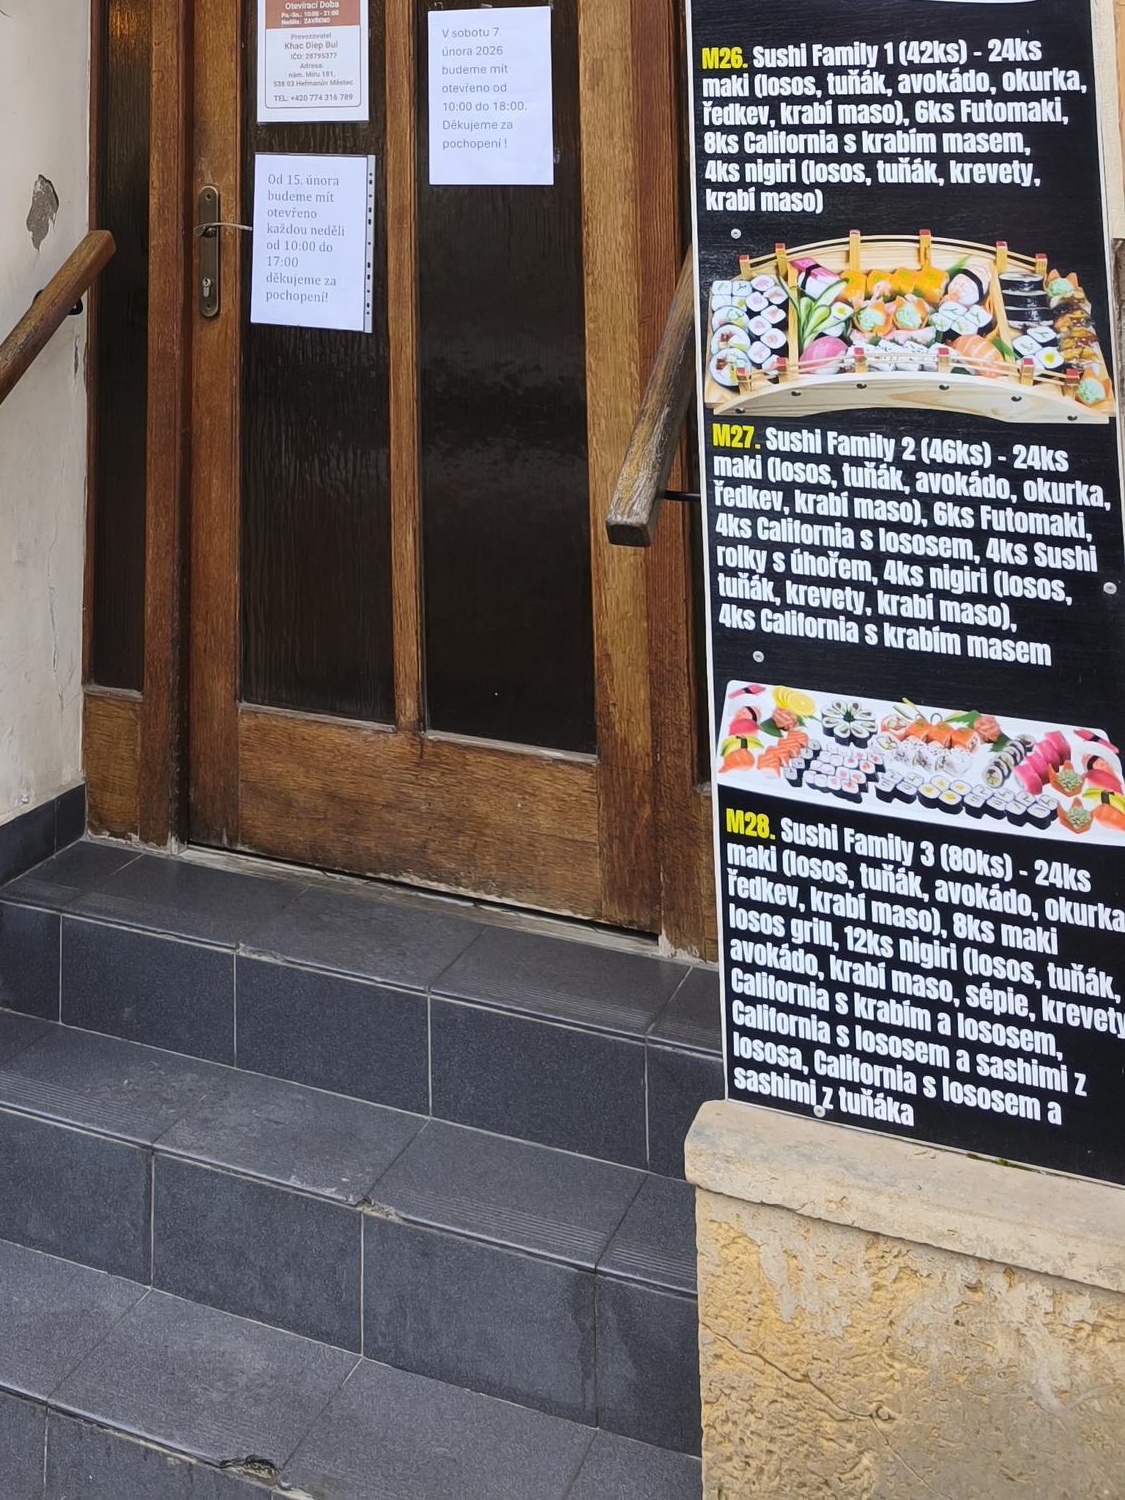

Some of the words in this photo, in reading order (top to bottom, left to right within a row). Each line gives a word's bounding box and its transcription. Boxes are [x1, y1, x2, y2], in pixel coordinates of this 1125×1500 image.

[442, 29, 449, 38] V
[452, 28, 489, 37] sobotu
[492, 28, 503, 36] 7.
[306, 42, 323, 50] Diep
[442, 47, 472, 56] února
[476, 46, 503, 55] 2026
[702, 47, 748, 69] M26.
[753, 43, 807, 68] Sushi
[812, 41, 879, 69] Family
[884, 43, 893, 65] 1
[899, 39, 967, 66] (42ks)
[988, 38, 1042, 62] 24ks
[442, 65, 487, 74] budeme
[490, 64, 507, 74] mít
[442, 82, 490, 92] otevřeno
[493, 83, 507, 92] od
[703, 73, 749, 97] maki
[755, 72, 822, 98] (losos,
[828, 70, 893, 97] tuňák,
[898, 69, 997, 96] avokádo,
[1002, 69, 1086, 94] okurka,
[443, 102, 472, 111] 10:00
[475, 102, 489, 111] do
[494, 101, 527, 110] 18:00.
[703, 101, 775, 127] ředkev,
[781, 100, 832, 124] krabí
[838, 100, 909, 127] maso),
[915, 100, 955, 123] 6ks
[961, 98, 1068, 126] Futomaki,
[443, 119, 497, 131] Děkujeme
[501, 121, 513, 129] za
[443, 138, 501, 150] pochopení
[705, 131, 738, 154] 8ks
[744, 129, 836, 154] California
[844, 132, 856, 153] s
[862, 128, 936, 153] krabím
[943, 131, 1031, 155] masem,
[705, 160, 740, 183] 4ks
[745, 159, 796, 186] nigiri
[802, 159, 871, 186] (losos,
[877, 158, 945, 186] tuňák,
[950, 160, 1041, 187] krevety,
[268, 174, 283, 185] Od
[288, 174, 303, 185] 15.
[307, 174, 339, 186] února
[268, 190, 312, 202] budeme
[315, 192, 334, 202] mít
[706, 188, 755, 212] krabí
[761, 188, 823, 214] maso)
[267, 208, 317, 218] otevřeno
[267, 223, 307, 234] každou
[311, 225, 345, 236] neděli
[267, 240, 279, 250] od
[285, 241, 315, 251] 10:00
[319, 241, 333, 252] do
[267, 256, 298, 267] 17:00
[266, 272, 321, 286] děkujeme
[324, 277, 336, 286] za
[266, 290, 328, 304] pochopení!
[712, 423, 760, 449] M27.
[766, 427, 821, 455] Sushi
[827, 430, 895, 462] Family
[902, 436, 916, 461] 2
[921, 438, 991, 468] (46ks)
[1013, 445, 1068, 472] 24ks
[726, 808, 776, 840] M28.
[780, 817, 838, 850] Sushi
[844, 827, 914, 867] Family
[920, 841, 934, 866] 3
[940, 843, 1013, 880] (80ks)
[1034, 859, 1091, 893] 24ks
